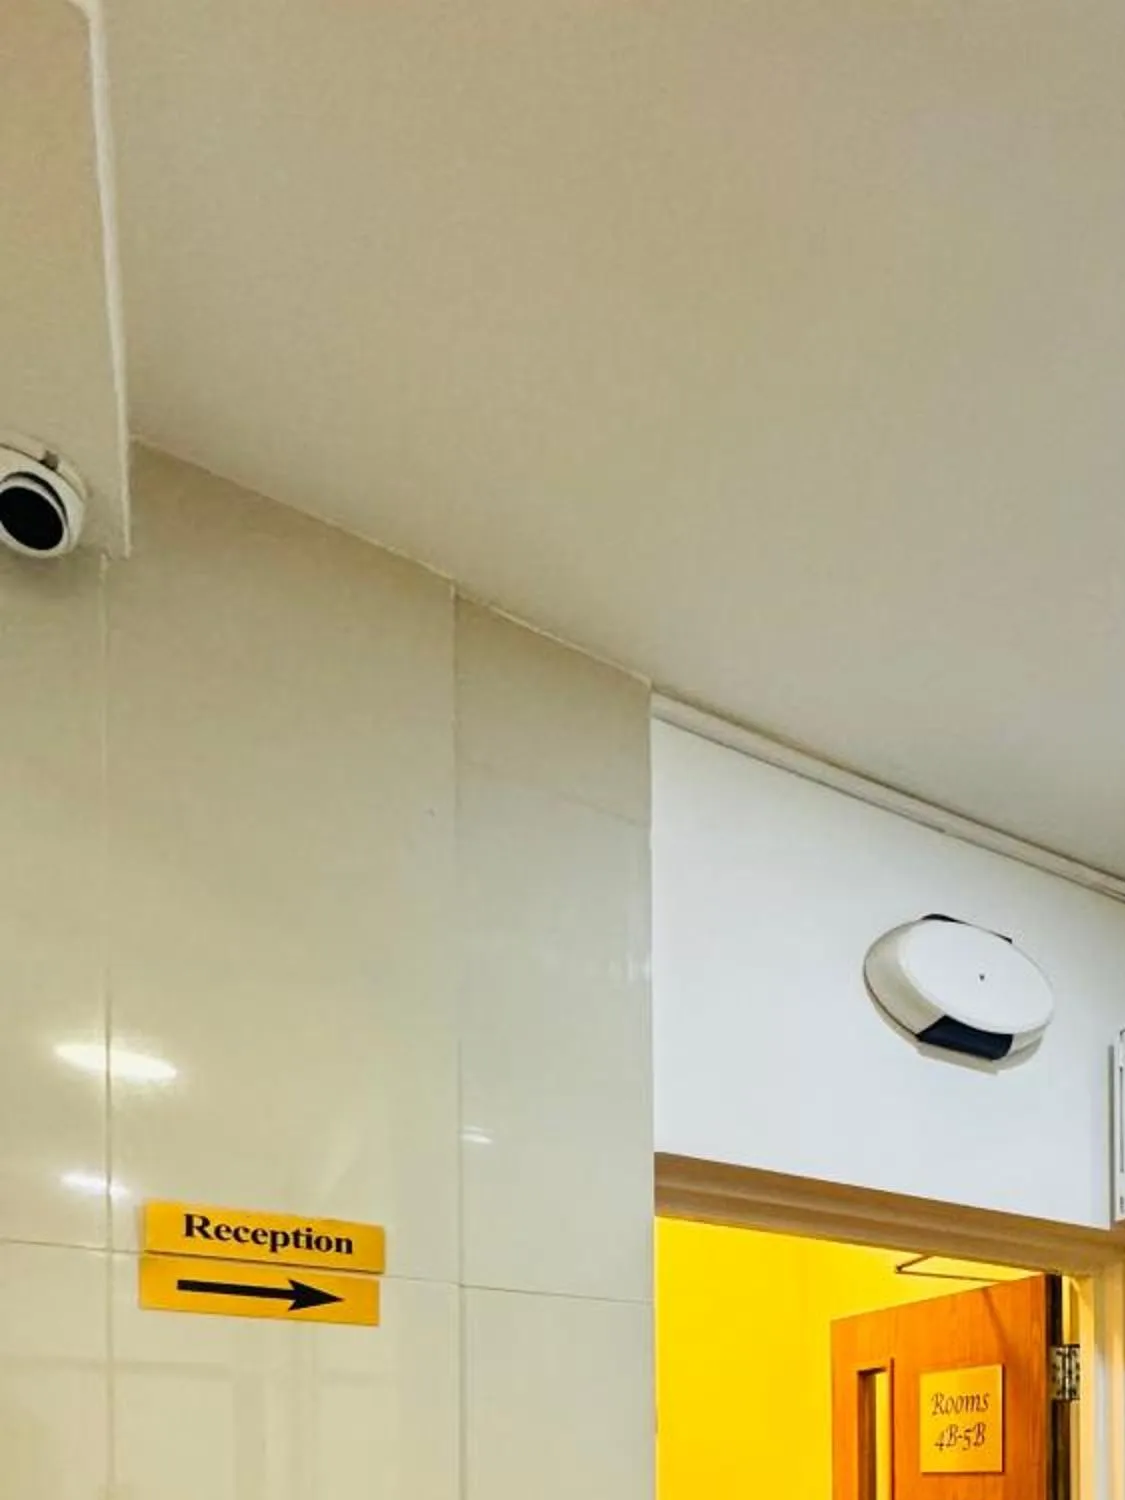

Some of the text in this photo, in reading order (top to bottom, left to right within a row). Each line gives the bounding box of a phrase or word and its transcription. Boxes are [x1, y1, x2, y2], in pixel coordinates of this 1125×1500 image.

[183, 1213, 353, 1255] Reception
[931, 1391, 990, 1415] Rooms
[934, 1422, 986, 1451] 4B-5B
